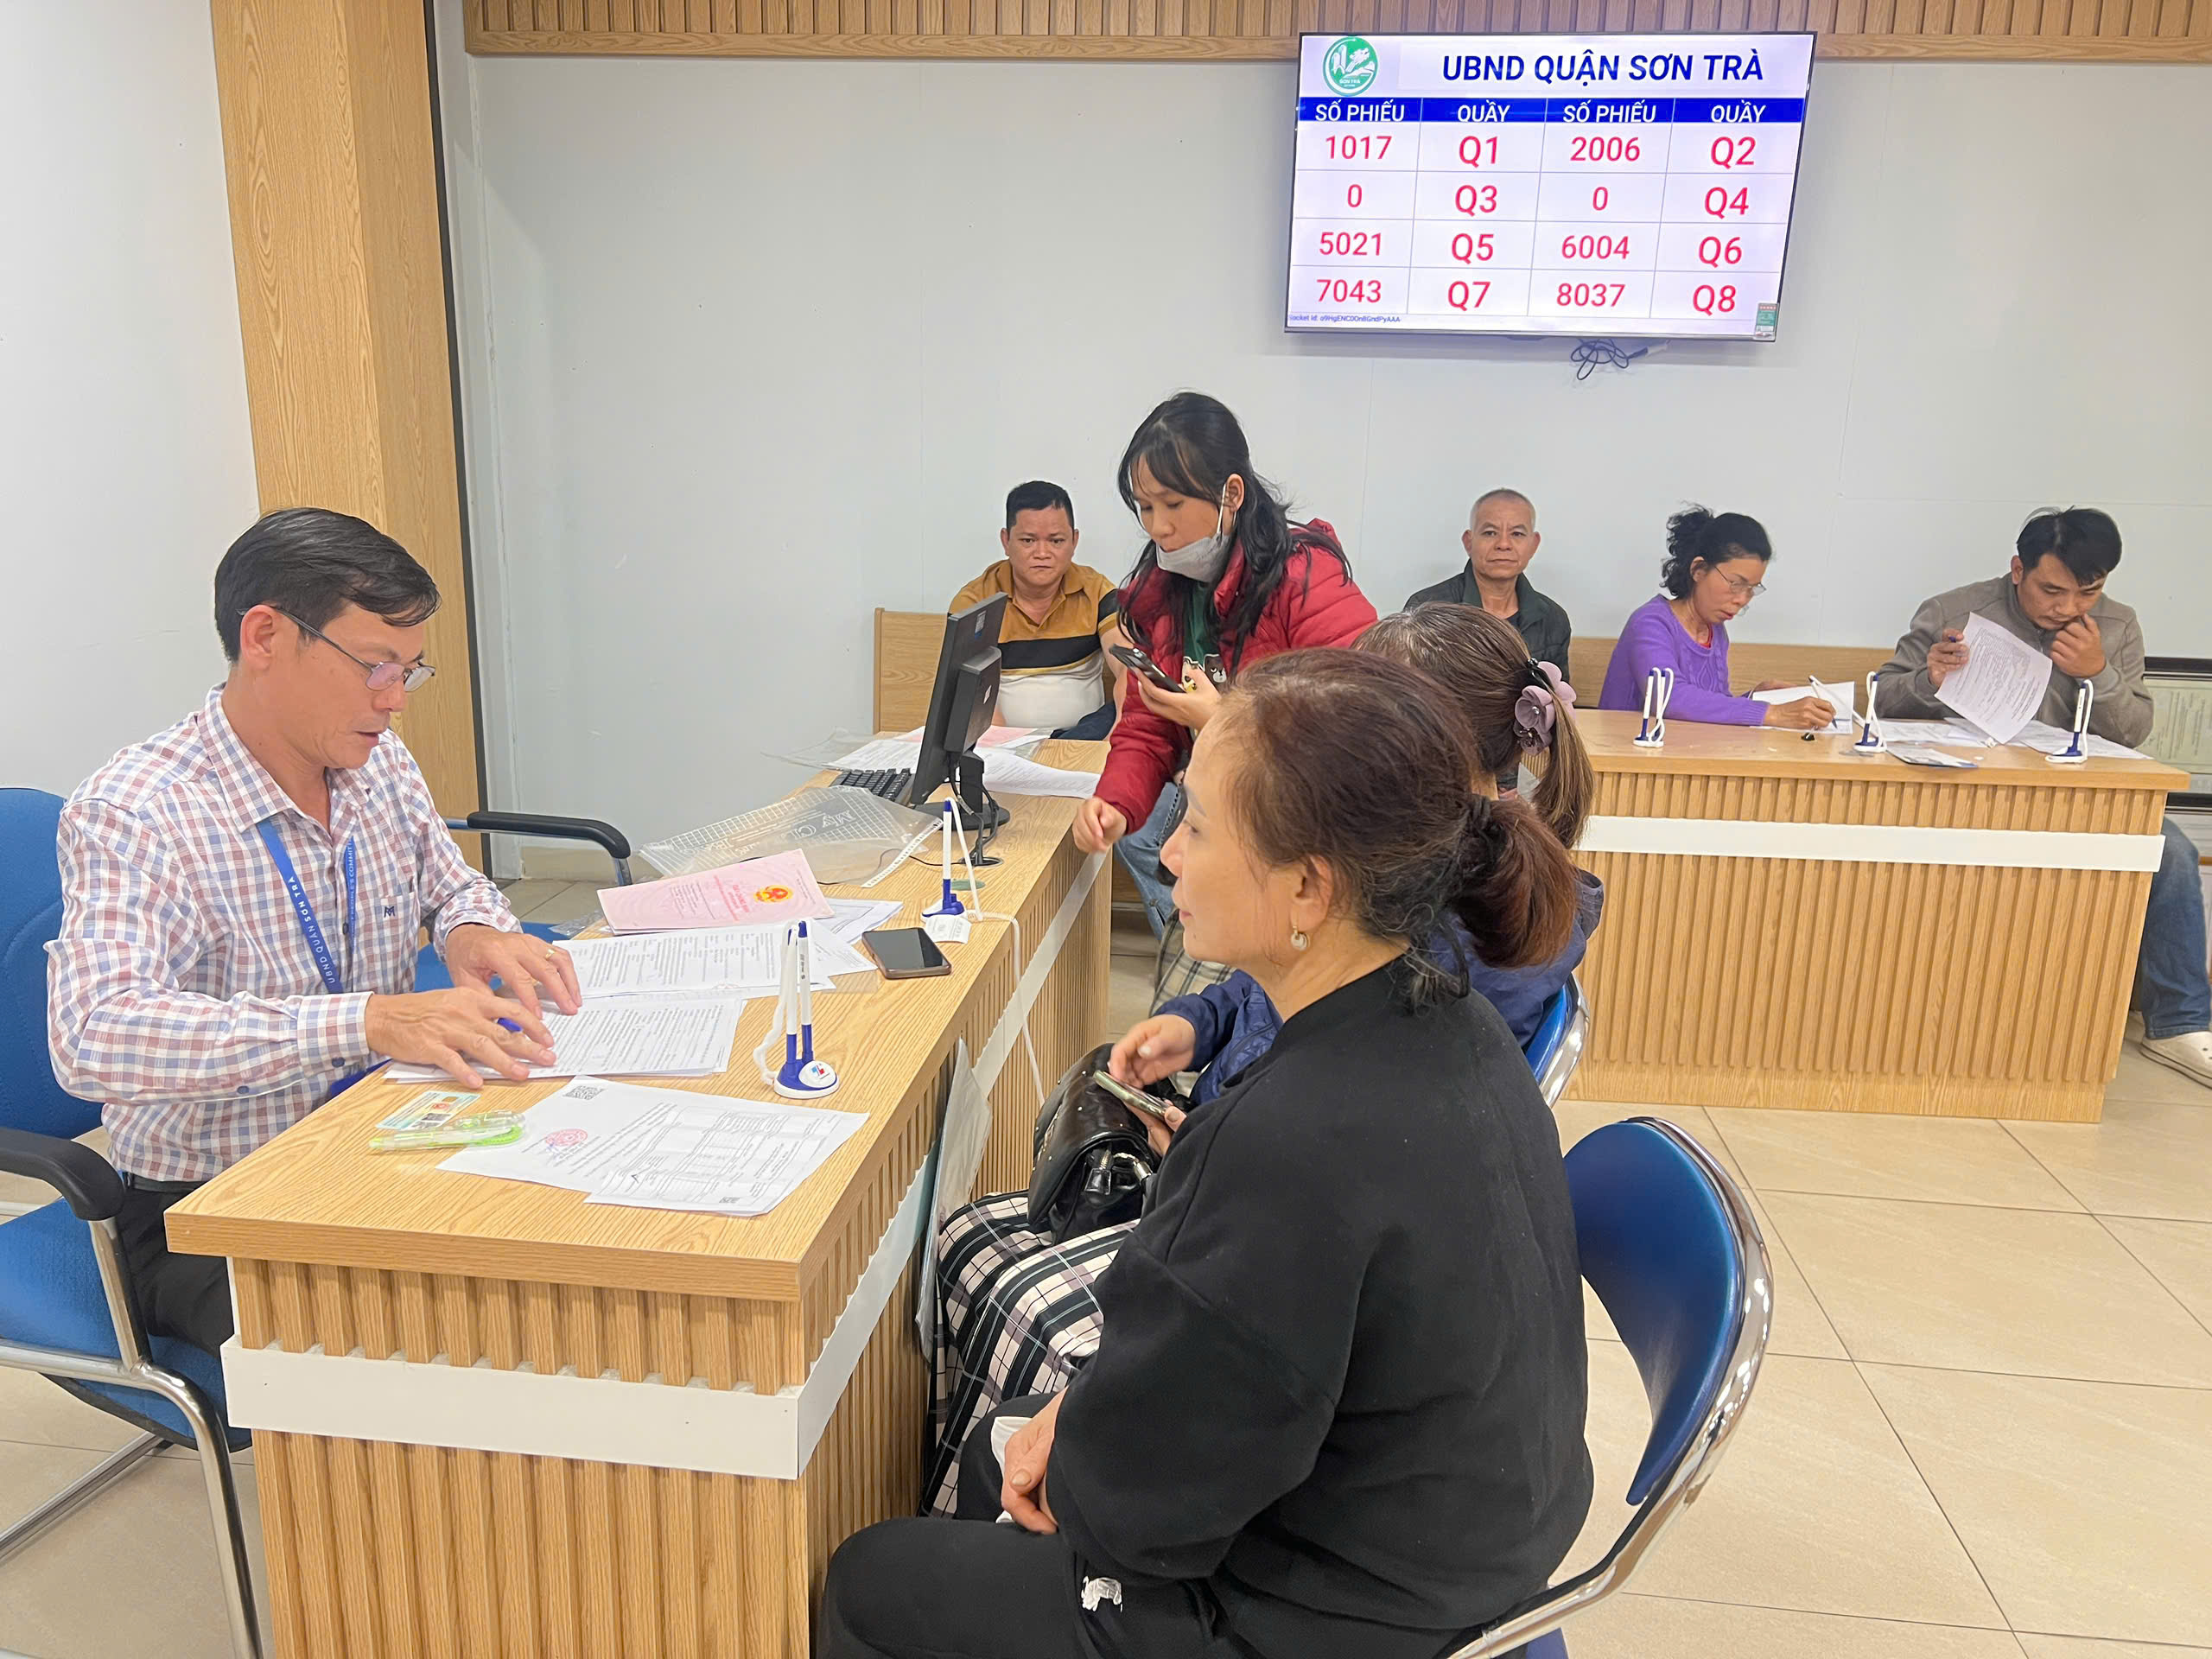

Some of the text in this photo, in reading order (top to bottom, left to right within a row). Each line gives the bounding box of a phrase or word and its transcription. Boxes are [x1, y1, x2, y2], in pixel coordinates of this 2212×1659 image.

[1443, 48, 1764, 87] UBND QUẬN SƠN TRÀ
[1315, 99, 1405, 121] SỐ PHIẾU
[1458, 99, 1510, 122] QUẦY
[1563, 99, 1656, 122] SỐ PHIẾU
[1711, 99, 1766, 122] QUẦY
[1325, 136, 1392, 159] 1017
[1459, 136, 1498, 168] Q1
[1570, 137, 1640, 162] 2006
[1710, 137, 1757, 169] Q2
[1347, 184, 1363, 207] 0
[1454, 185, 1497, 216] Q3
[1592, 187, 1608, 211] 0
[1704, 187, 1749, 219] Q4
[1319, 232, 1382, 257] 5021
[1452, 233, 1494, 264] Q5
[1561, 235, 1630, 259] 6004
[1698, 237, 1742, 268] Q6
[1316, 279, 1382, 302] 7043
[1447, 282, 1491, 311] Q7
[1556, 283, 1625, 307] 8037
[1693, 285, 1736, 315] Q8
[320, 956, 335, 983] UBND
